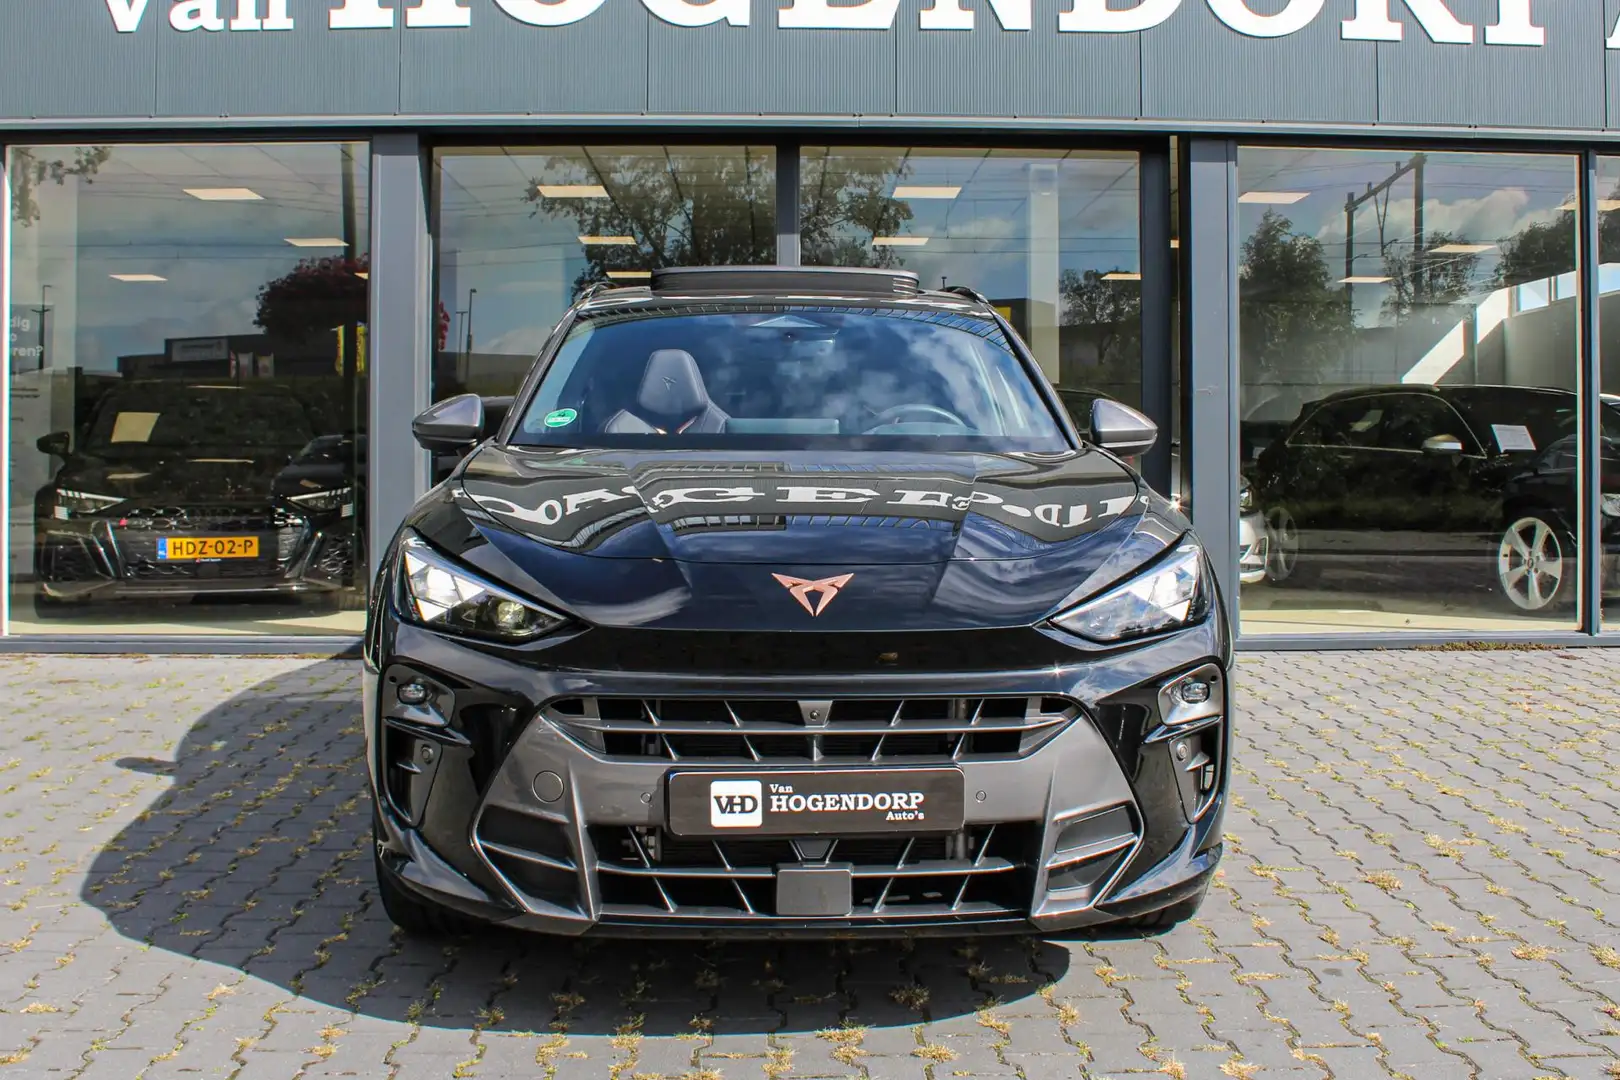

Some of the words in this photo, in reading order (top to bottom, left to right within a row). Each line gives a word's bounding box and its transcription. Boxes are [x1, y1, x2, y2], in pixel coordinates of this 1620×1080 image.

[172, 539, 254, 556] HDZ-02-P
[769, 784, 793, 794] Van
[713, 795, 759, 815] VHD
[769, 792, 925, 812] HOGENDORP
[885, 811, 925, 821] Auto's
